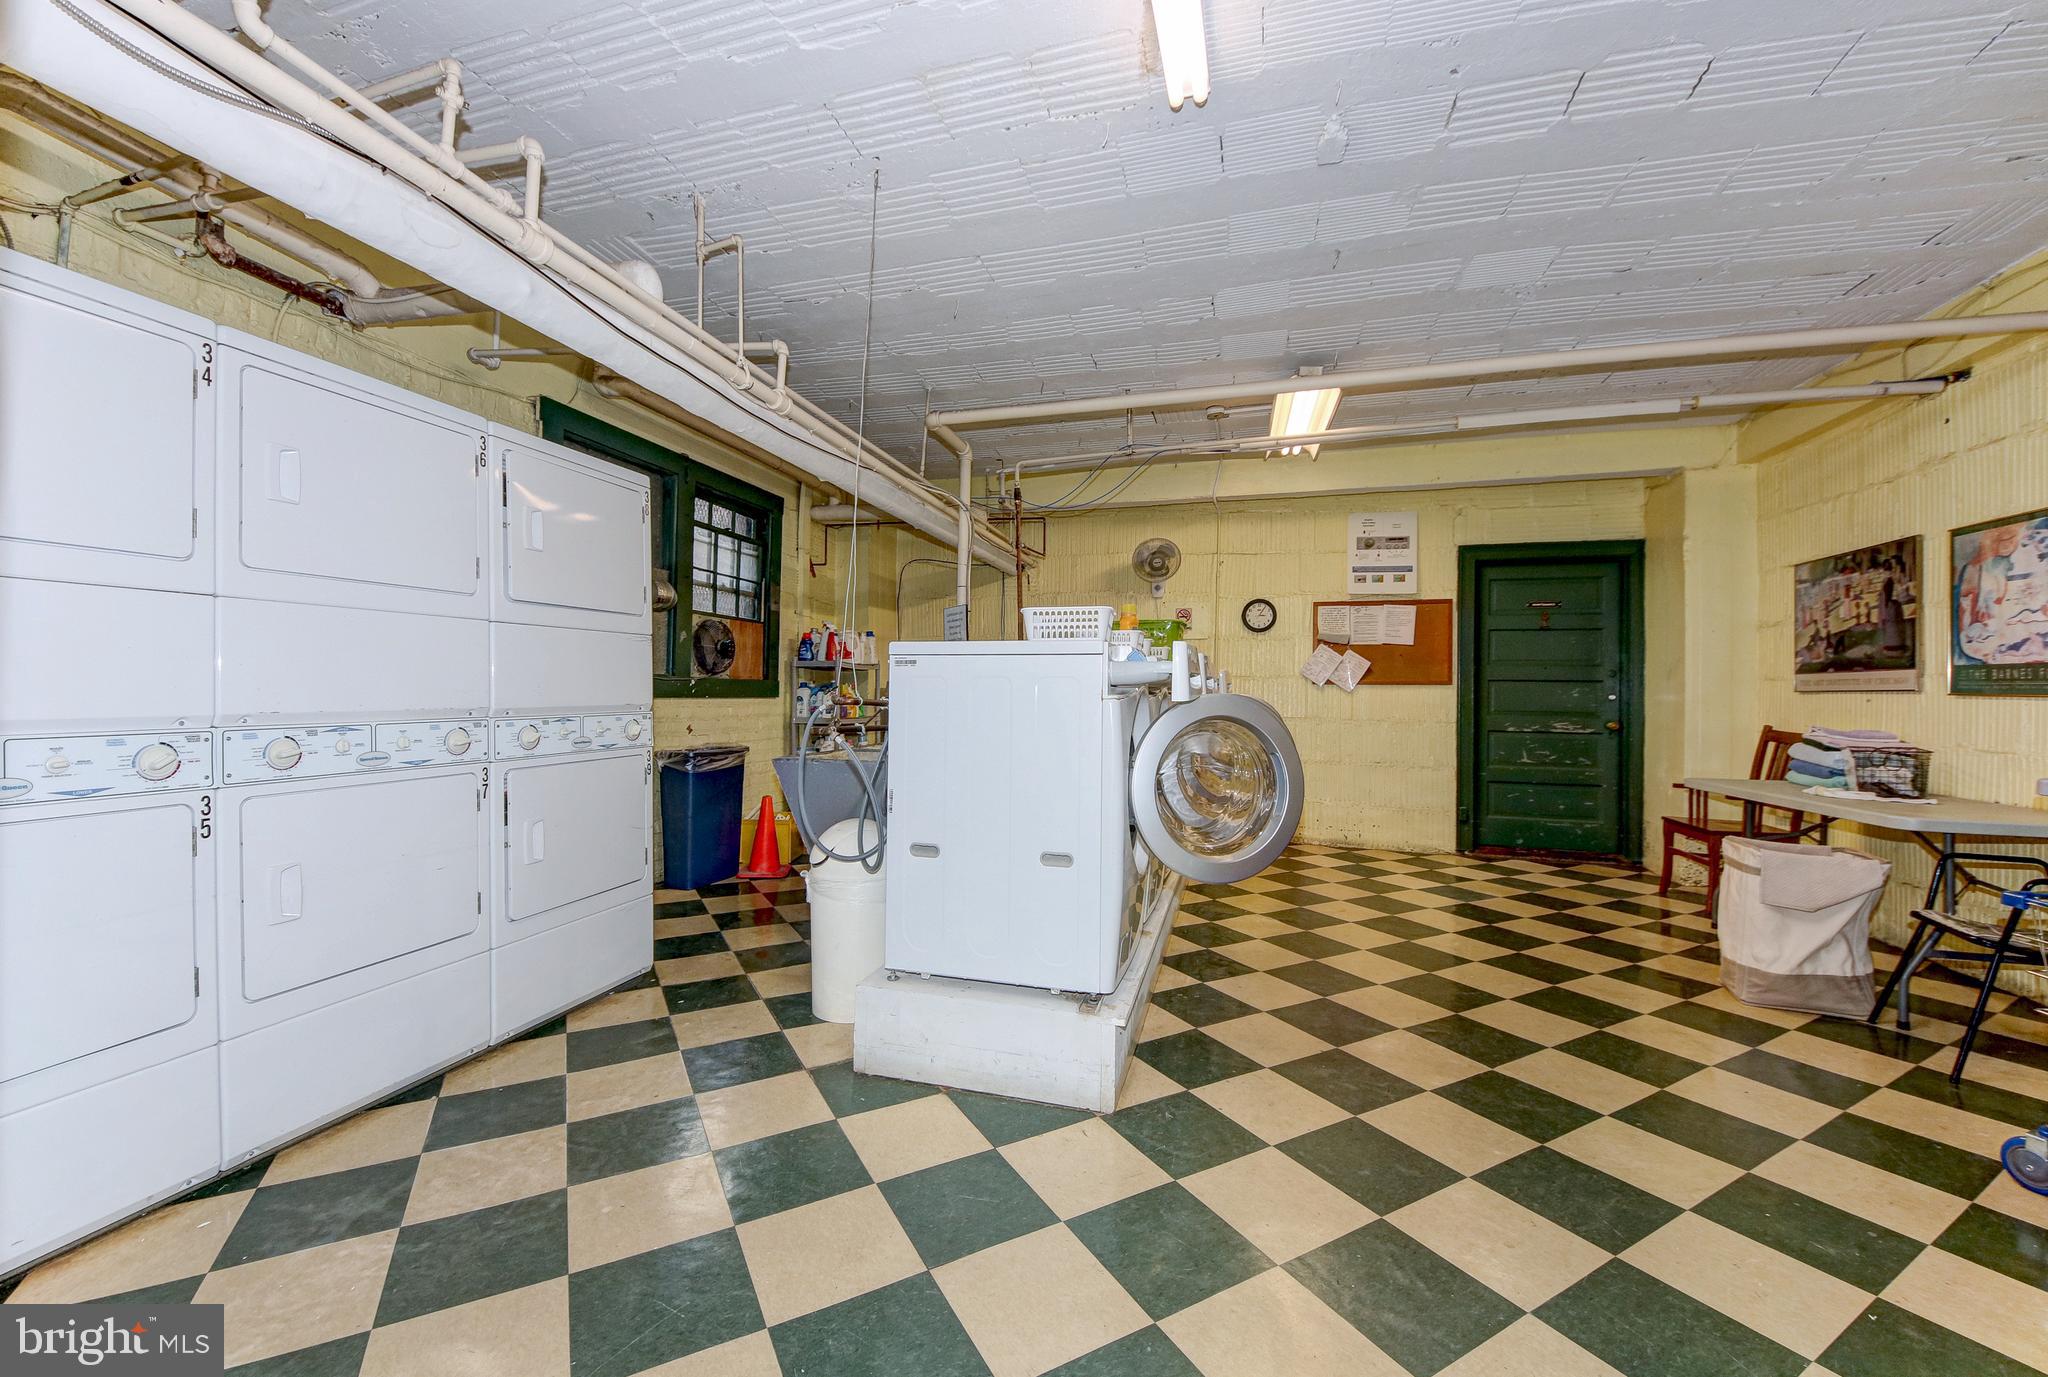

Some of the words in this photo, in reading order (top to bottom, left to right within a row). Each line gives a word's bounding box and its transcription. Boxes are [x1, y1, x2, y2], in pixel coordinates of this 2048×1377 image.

[202, 342, 213, 387] 34
[479, 435, 487, 468] 36
[481, 766, 489, 799] 37
[200, 795, 212, 839] 35
